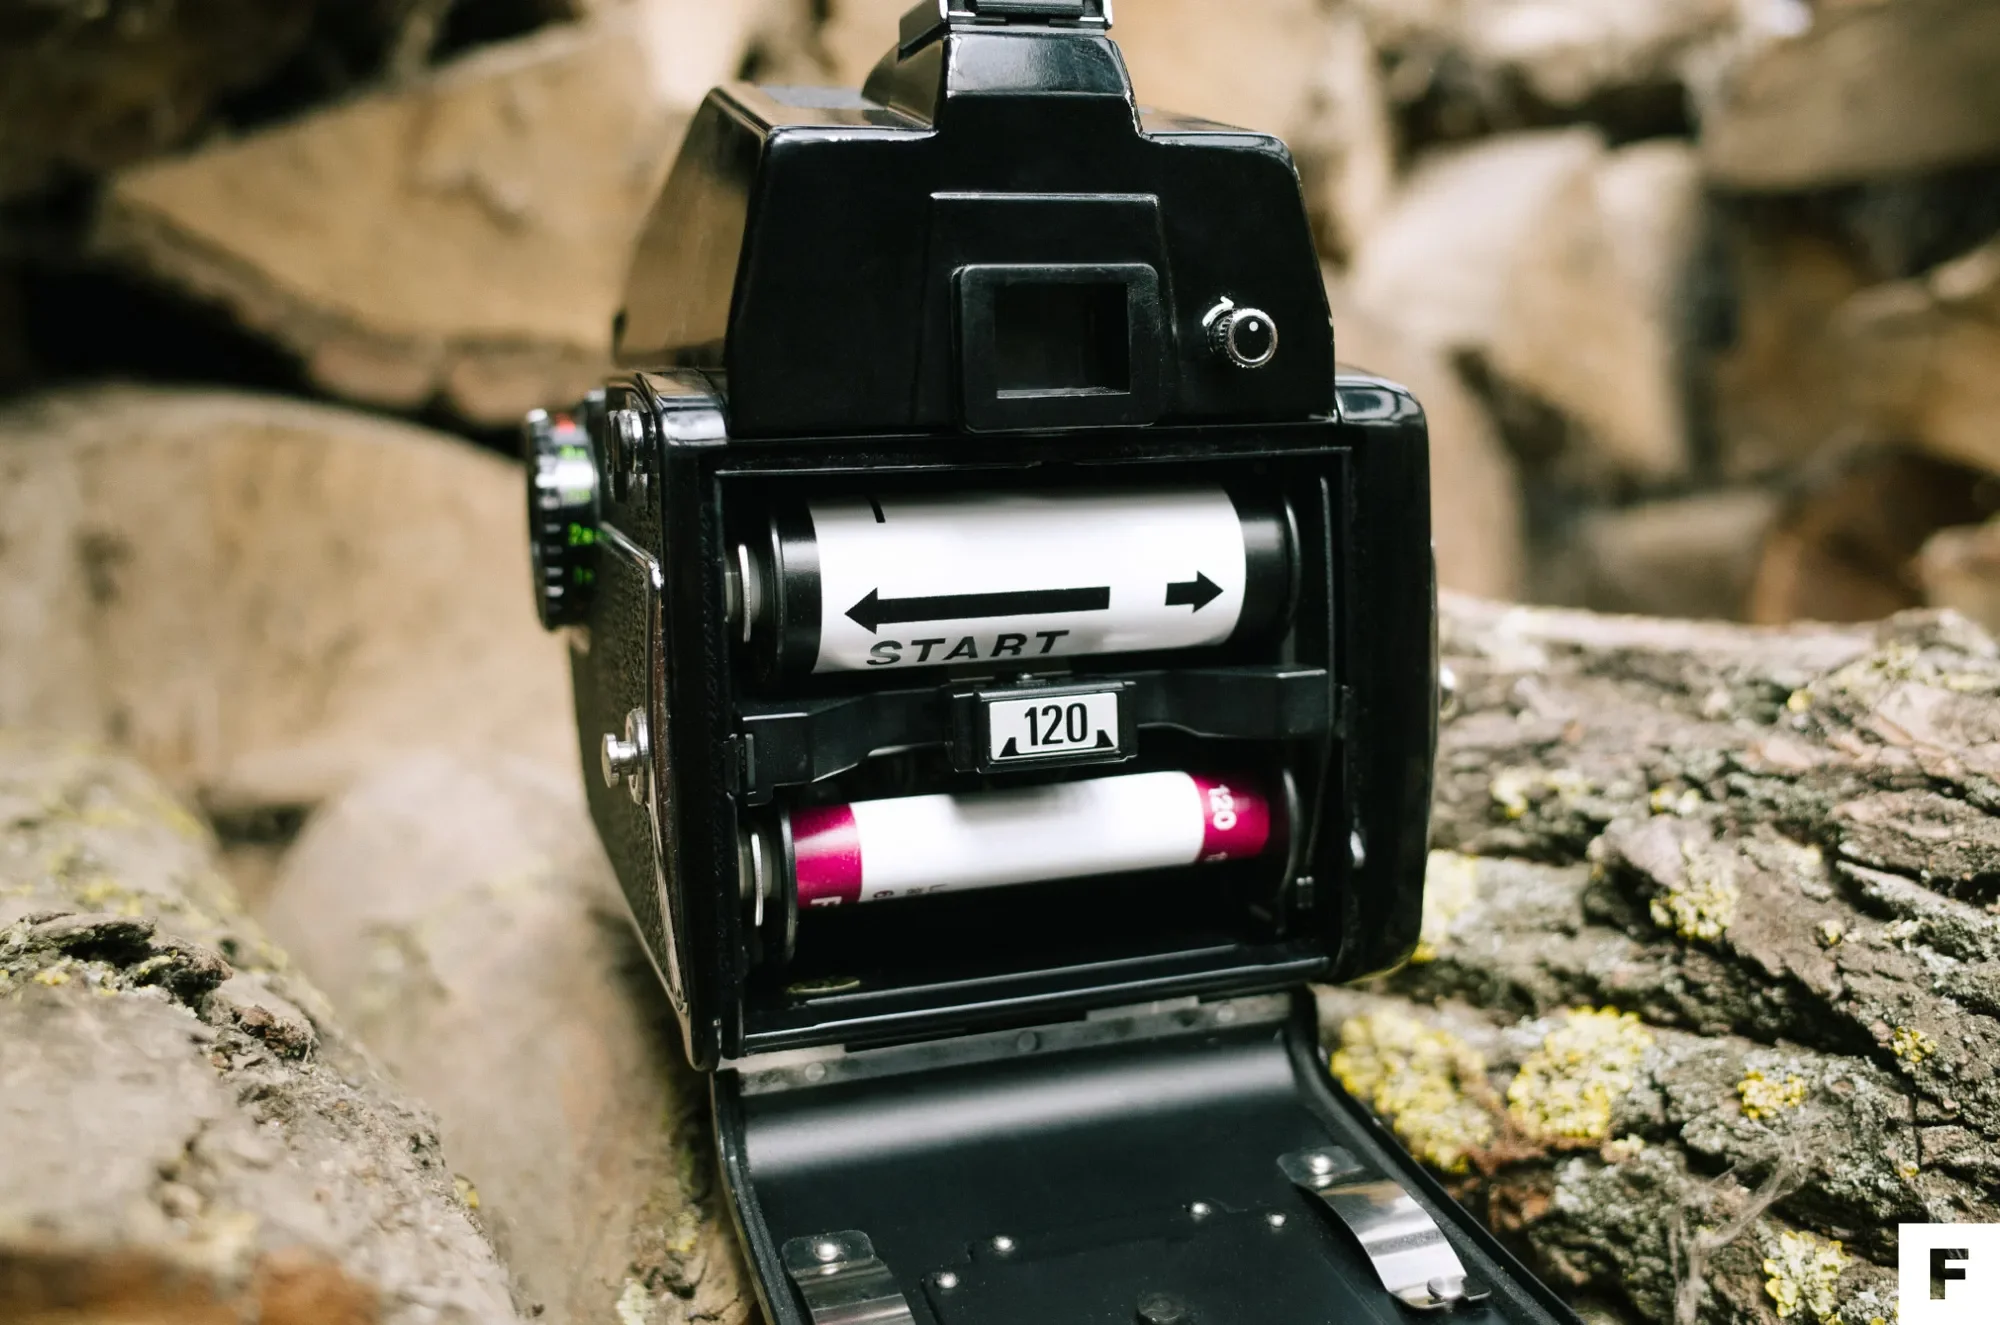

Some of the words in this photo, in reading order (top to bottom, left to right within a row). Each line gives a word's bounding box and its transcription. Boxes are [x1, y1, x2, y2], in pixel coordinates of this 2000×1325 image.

[866, 629, 1070, 666] START
[1024, 702, 1088, 746] 120
[1207, 783, 1237, 830] 120
